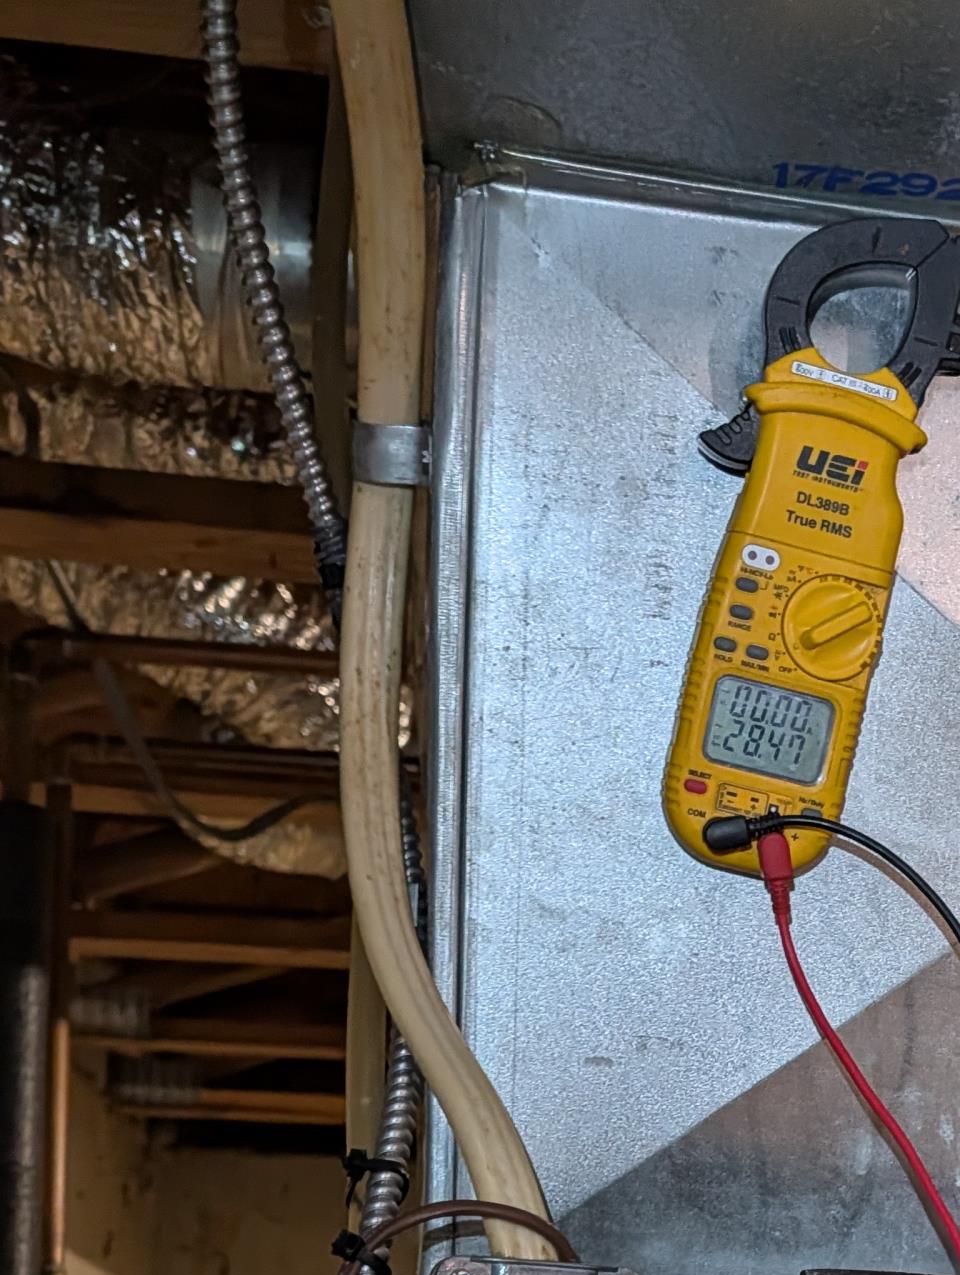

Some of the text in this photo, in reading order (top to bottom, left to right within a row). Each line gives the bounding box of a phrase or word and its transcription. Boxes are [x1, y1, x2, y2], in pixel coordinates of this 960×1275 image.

[796, 491, 850, 516] DL389B
[786, 509, 852, 538] True RMS
[778, 665, 793, 674] OFF
[723, 719, 806, 765] 28.47
[688, 808, 707, 818] COM
